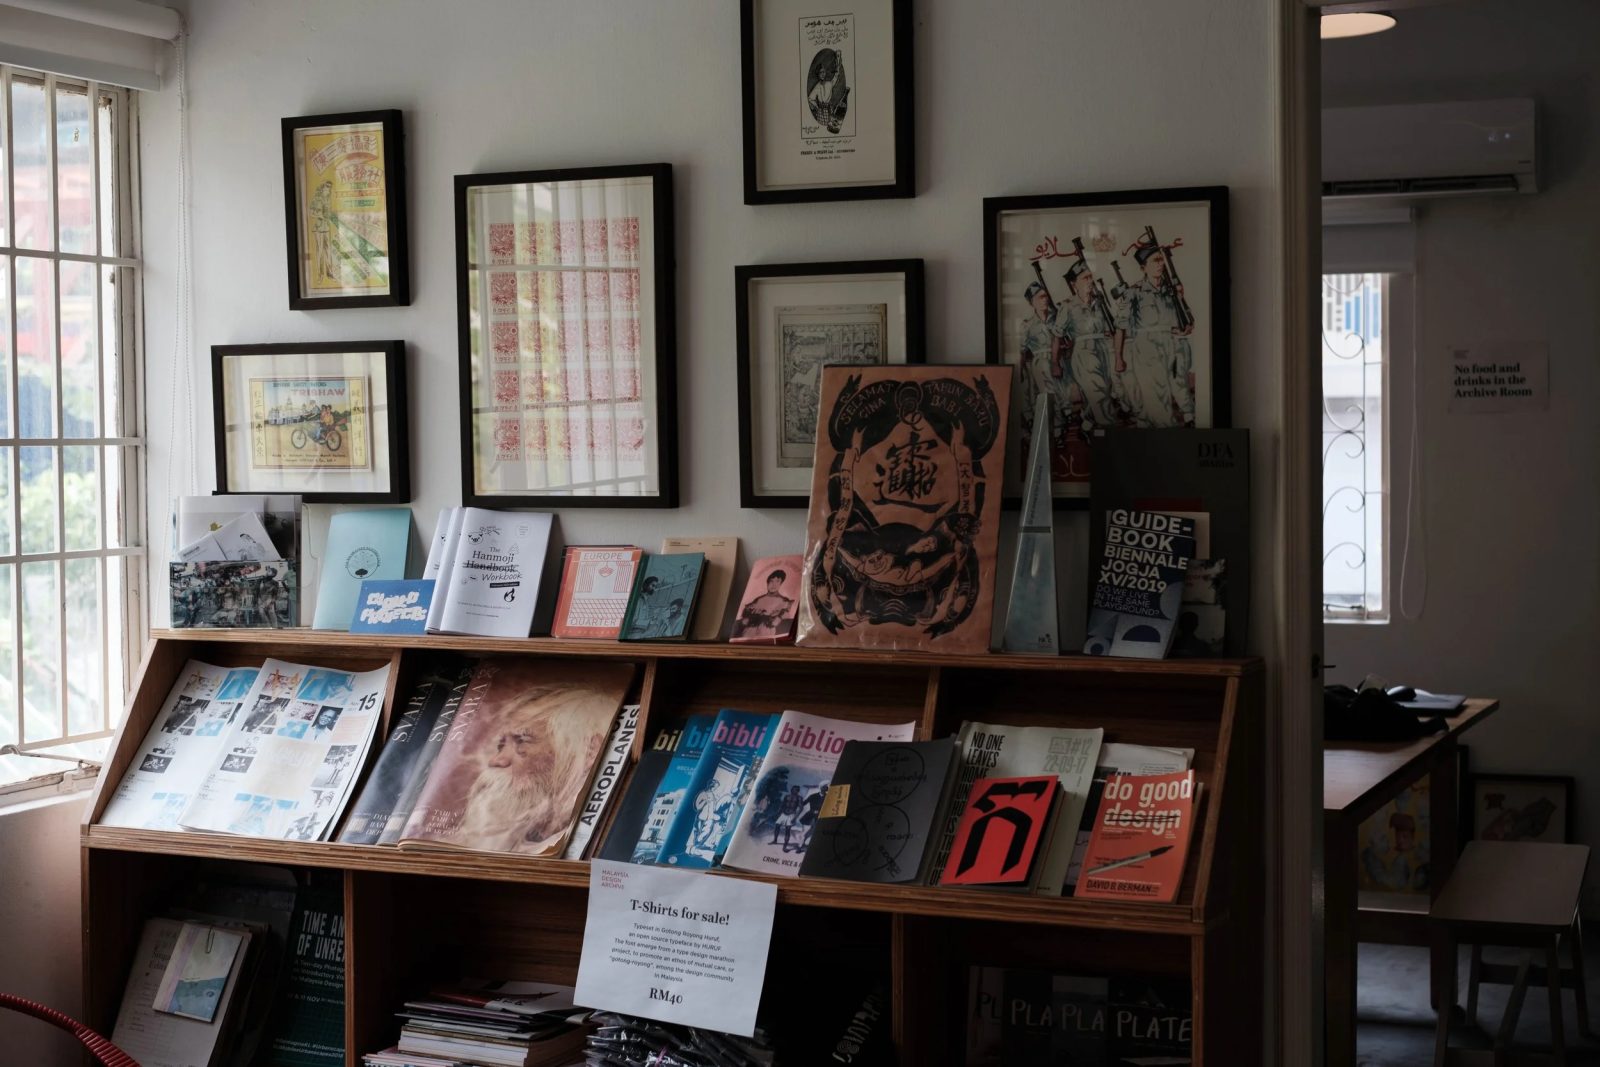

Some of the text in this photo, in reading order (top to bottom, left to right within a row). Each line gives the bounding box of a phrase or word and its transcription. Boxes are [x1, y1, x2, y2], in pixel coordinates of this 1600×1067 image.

[1455, 363, 1520, 374] No food and
[1454, 375, 1526, 386] drinks in the
[290, 388, 345, 396] TRISHAW
[1455, 387, 1532, 398] Archive Room
[840, 382, 988, 426] SELAMAT TAHUN BARU
[859, 395, 959, 419] CINA BABI
[1112, 509, 1192, 534] GUIDE-
[1107, 527, 1175, 552] BOOK
[466, 560, 517, 573] Handbook
[472, 550, 515, 564] Hanmoji
[1104, 544, 1189, 570] BIENNALE
[482, 572, 522, 581] Workbook
[1101, 559, 1160, 579] JOGJA
[1098, 570, 1167, 593] XV/2019
[1107, 594, 1123, 604] THE
[1125, 597, 1150, 609] SAME
[1130, 591, 1149, 600] LIVE
[1093, 599, 1160, 616] PLAYGROUND?
[359, 691, 378, 711] 15
[392, 682, 433, 742] SVARA
[428, 682, 468, 742] SVARA
[448, 683, 488, 742] SVARA
[971, 731, 1005, 751] NO ONE
[580, 708, 640, 826] AEROPLANES
[966, 749, 999, 768] LEAVES
[1104, 775, 1133, 800] do
[1138, 768, 1193, 808] good
[1104, 802, 1181, 835] design
[763, 856, 780, 865] CRIME,
[781, 859, 793, 867] VICE
[602, 869, 629, 878] MALAYSIA
[1086, 880, 1111, 890] DAVID
[1118, 882, 1152, 892] BERMAN
[303, 910, 327, 934] TIME
[630, 899, 730, 926] T-Shirts for sale!
[634, 923, 654, 931] Typeset
[661, 927, 682, 936] Gotong
[682, 930, 703, 940] Royong
[296, 933, 312, 956] OF
[625, 939, 636, 947] font
[637, 942, 657, 951] emerge
[677, 948, 689, 956] type
[690, 950, 708, 959] design
[709, 953, 735, 963] marathon
[669, 938, 692, 947] typeface
[612, 947, 631, 956] project,
[640, 952, 663, 961] promote
[671, 956, 687, 964] ethos
[694, 961, 713, 969] mutual
[655, 964, 675, 973] among
[675, 965, 684, 973] the
[685, 968, 703, 977] design
[704, 971, 735, 983] community
[661, 974, 683, 983] Malaysia
[649, 987, 683, 1005] RM40
[1011, 999, 1053, 1027] PLA
[1062, 1003, 1104, 1032] PLA
[1117, 1010, 1192, 1042] PLATE
